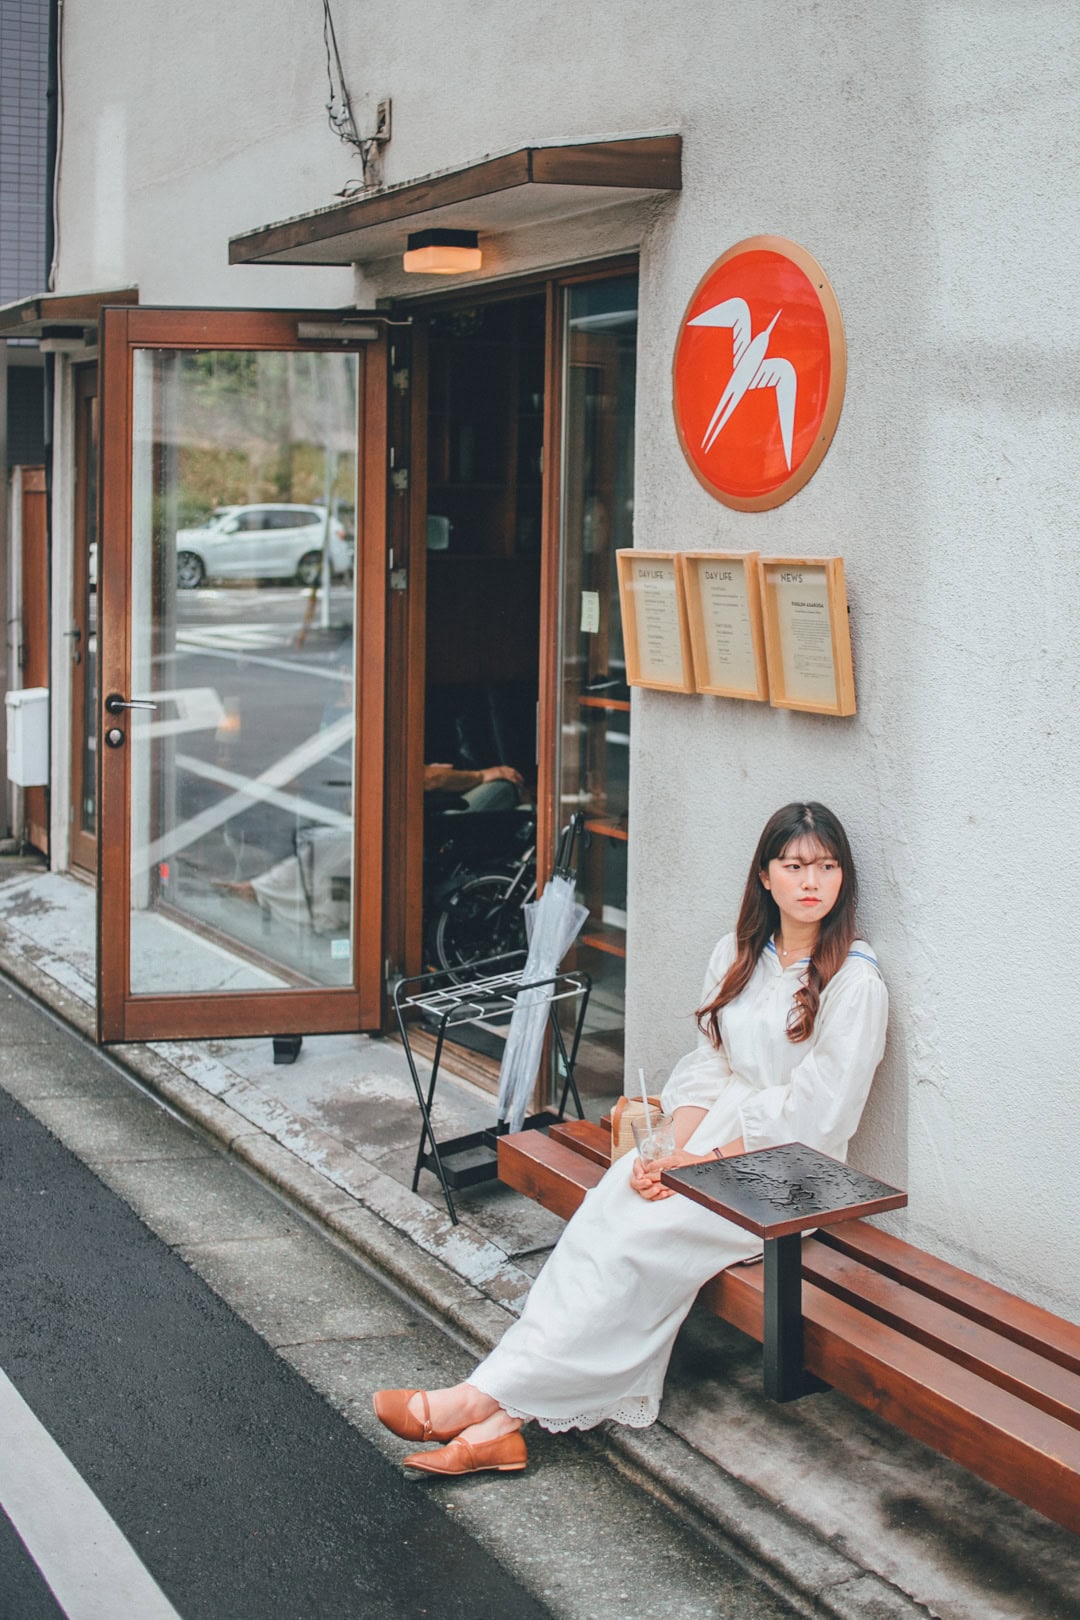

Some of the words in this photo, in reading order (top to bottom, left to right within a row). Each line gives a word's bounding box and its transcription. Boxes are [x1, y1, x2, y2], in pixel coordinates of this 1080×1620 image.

[705, 571, 718, 580] DAY
[719, 571, 733, 581] LIFE
[780, 573, 803, 583] NEWS
